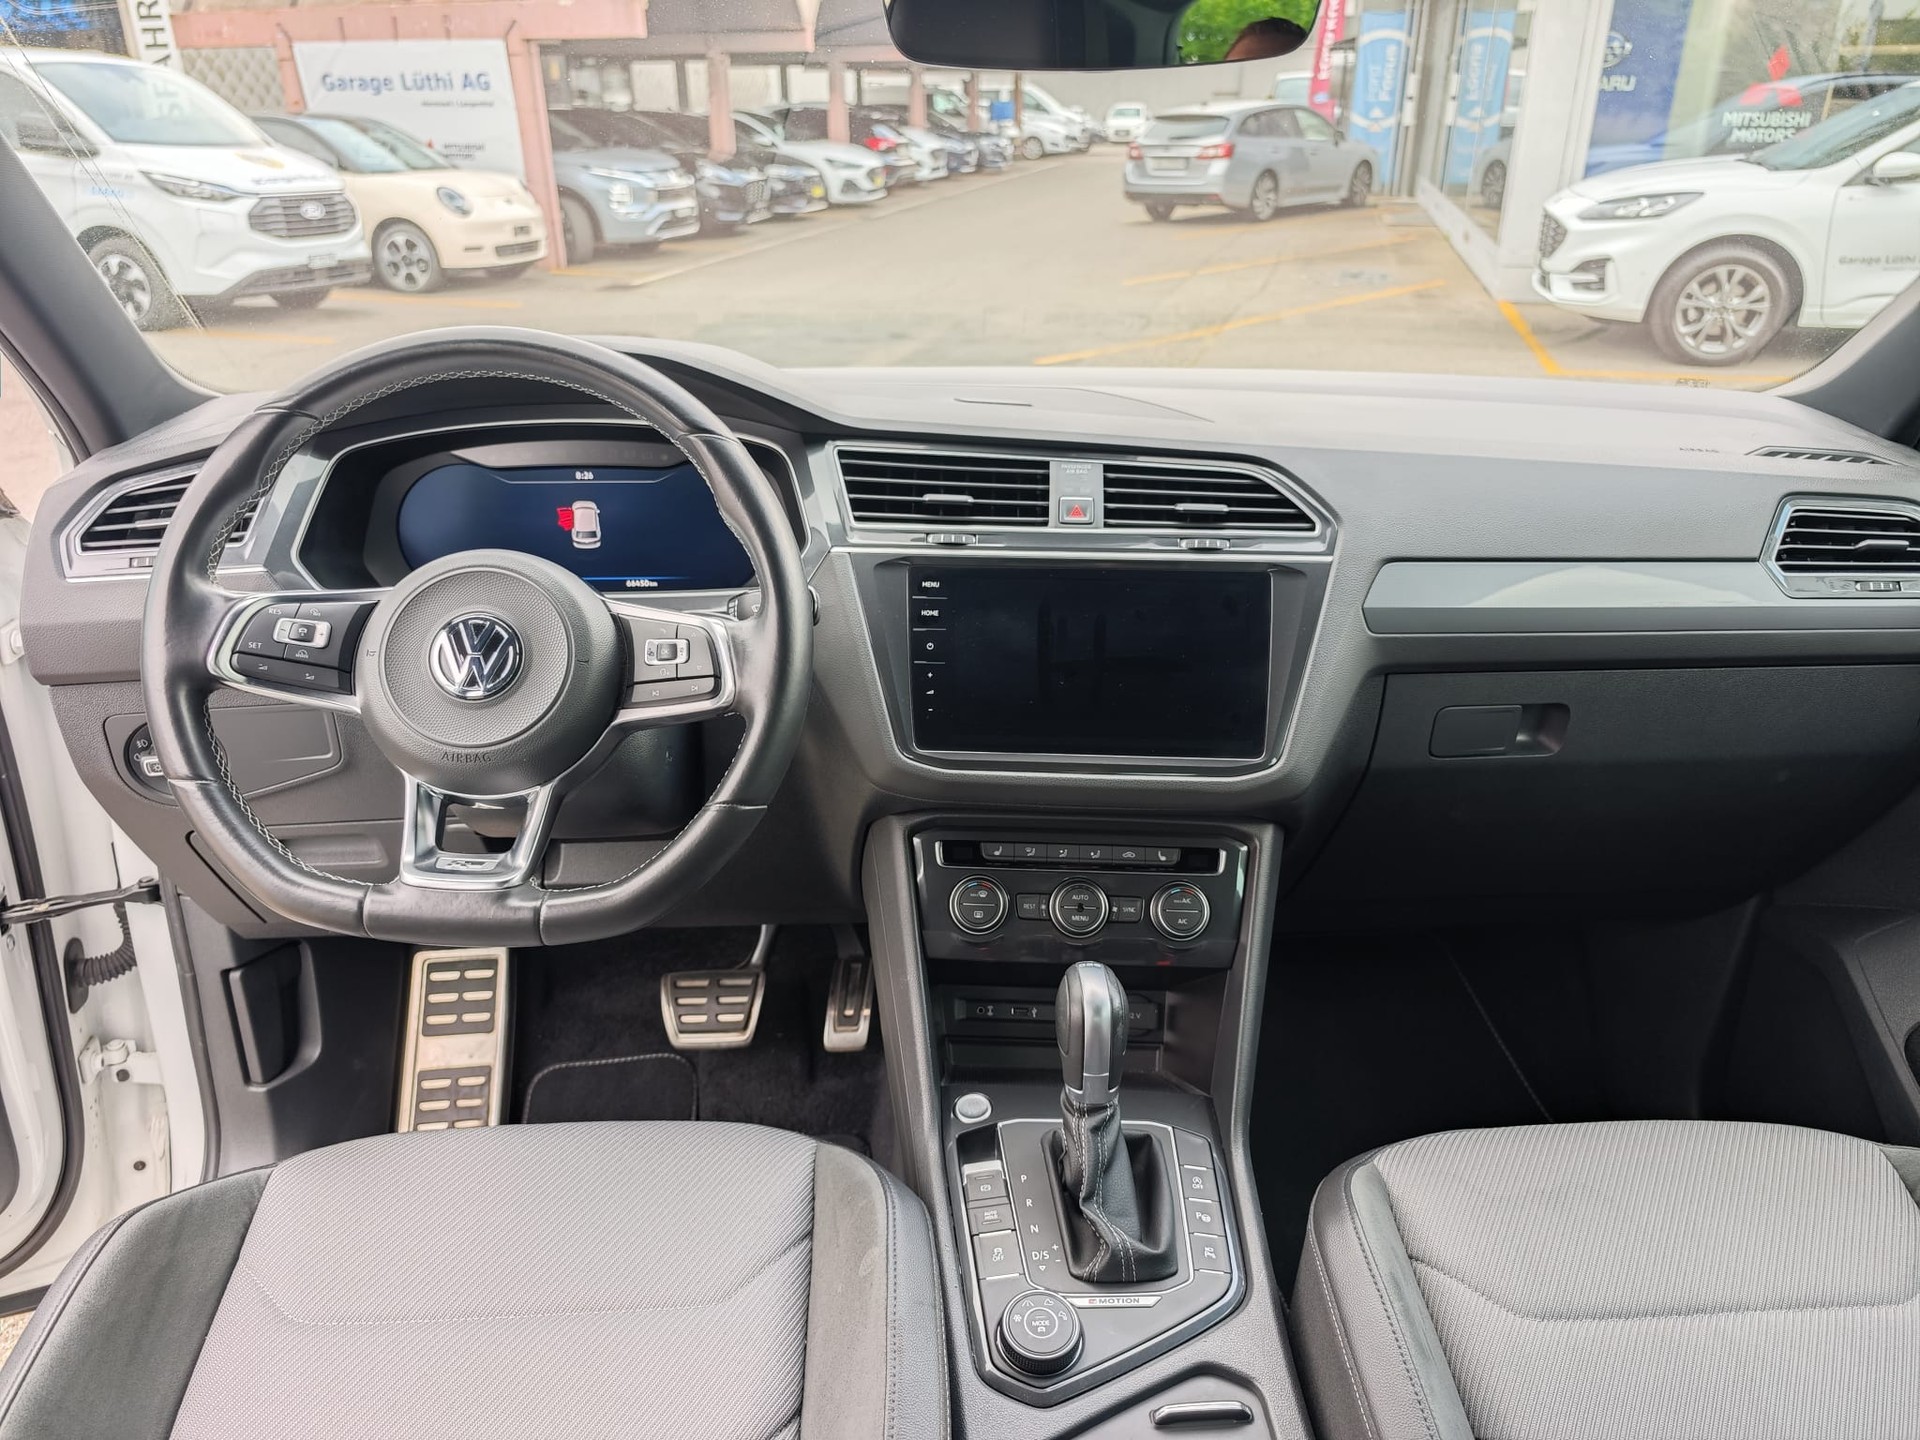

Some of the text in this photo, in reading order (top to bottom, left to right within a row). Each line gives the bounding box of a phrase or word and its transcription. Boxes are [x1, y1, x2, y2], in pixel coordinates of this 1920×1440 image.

[321, 72, 491, 95] Garage Lüthi AG
[1722, 111, 1812, 127] MITSUBISHI
[441, 752, 492, 763] AIRBAG
[1020, 1174, 1027, 1183] P
[1025, 1198, 1033, 1208] R
[1030, 1224, 1039, 1234] N
[1031, 1250, 1050, 1261] D/S
[1031, 1319, 1051, 1327] MODE
